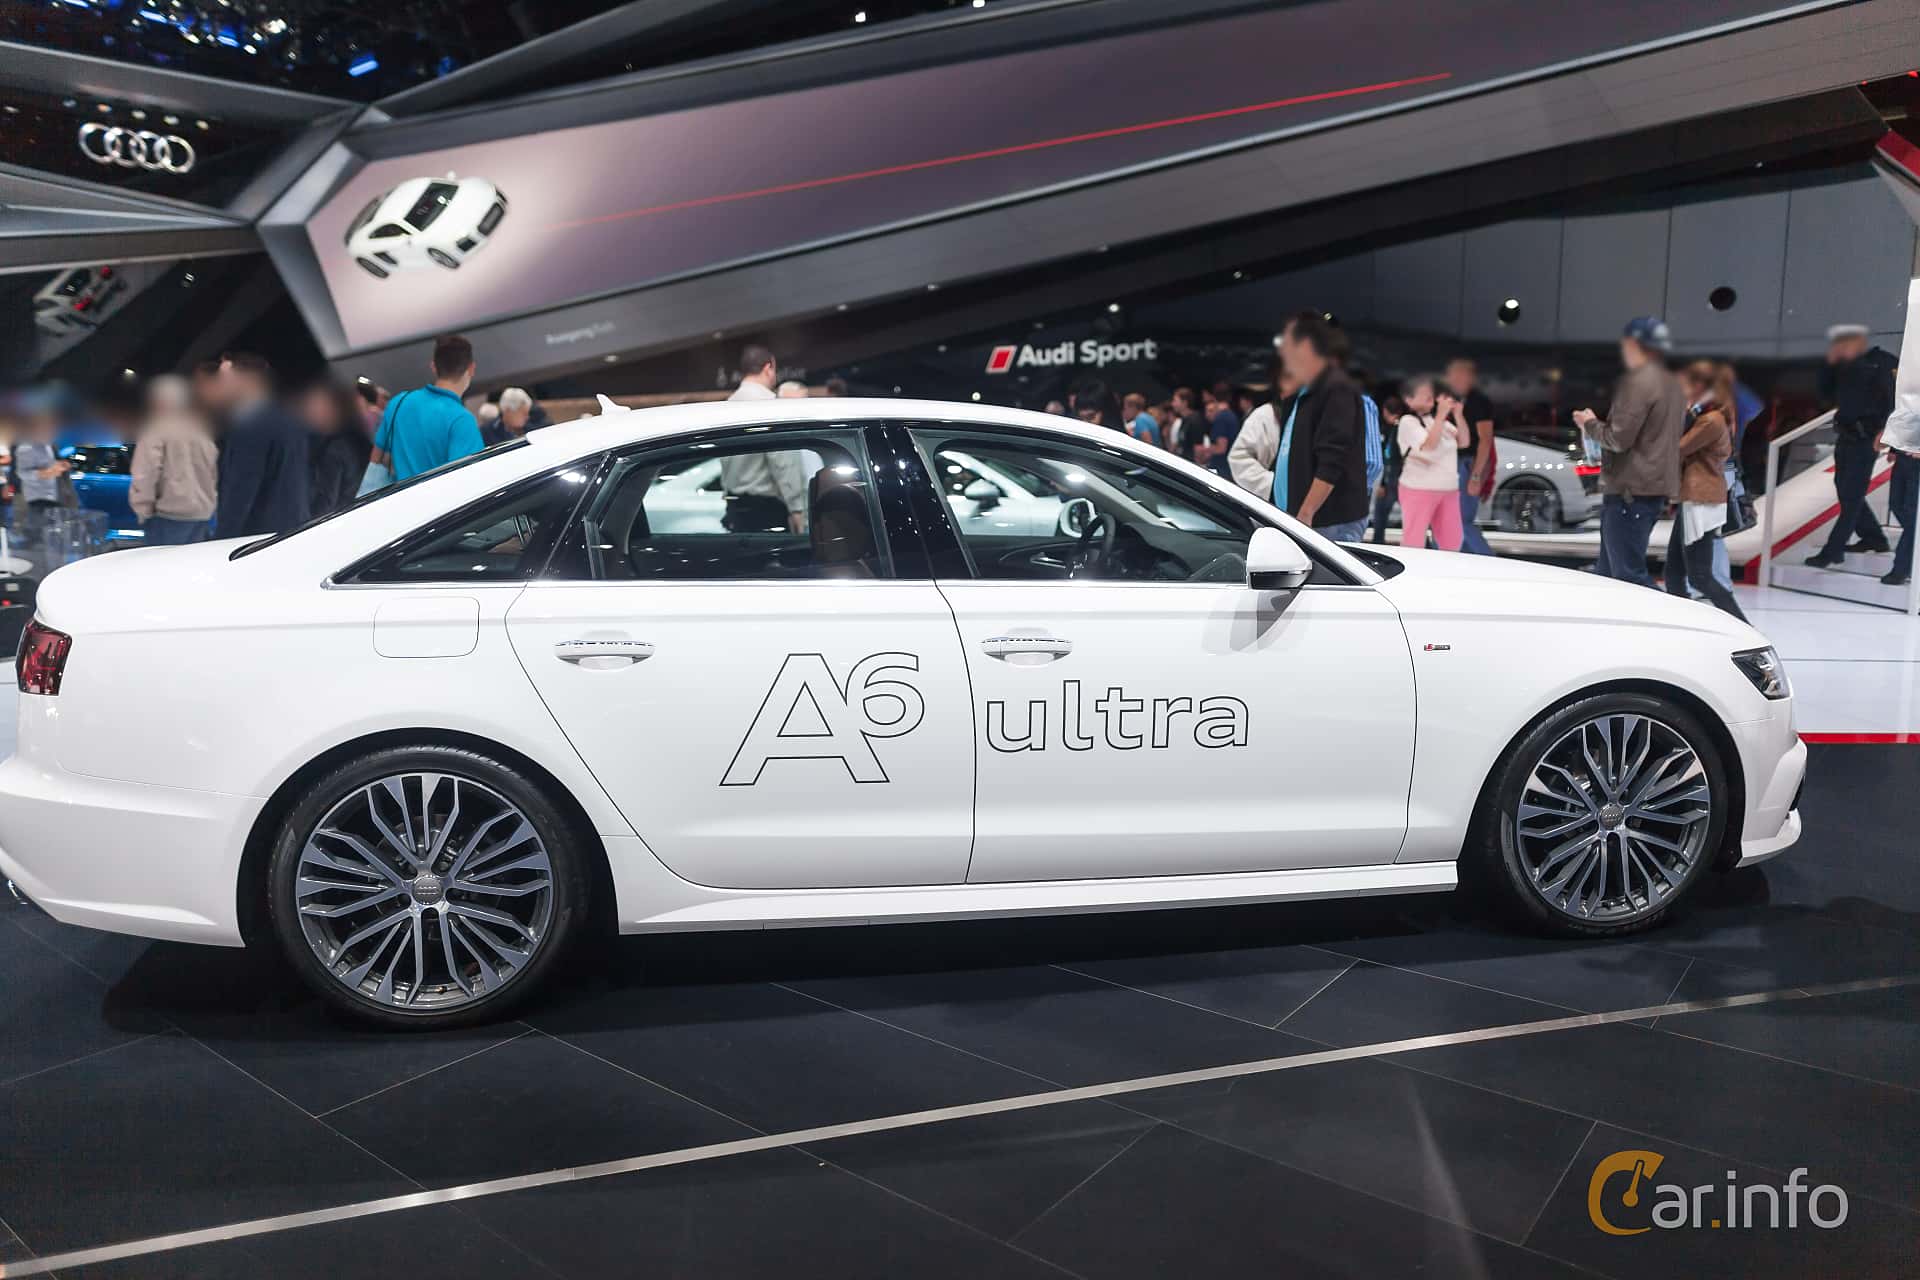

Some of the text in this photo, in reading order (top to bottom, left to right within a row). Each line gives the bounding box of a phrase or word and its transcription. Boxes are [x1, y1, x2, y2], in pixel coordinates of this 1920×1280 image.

[1016, 338, 1158, 368] Audi Sport
[719, 651, 1250, 786] A6 ultra
